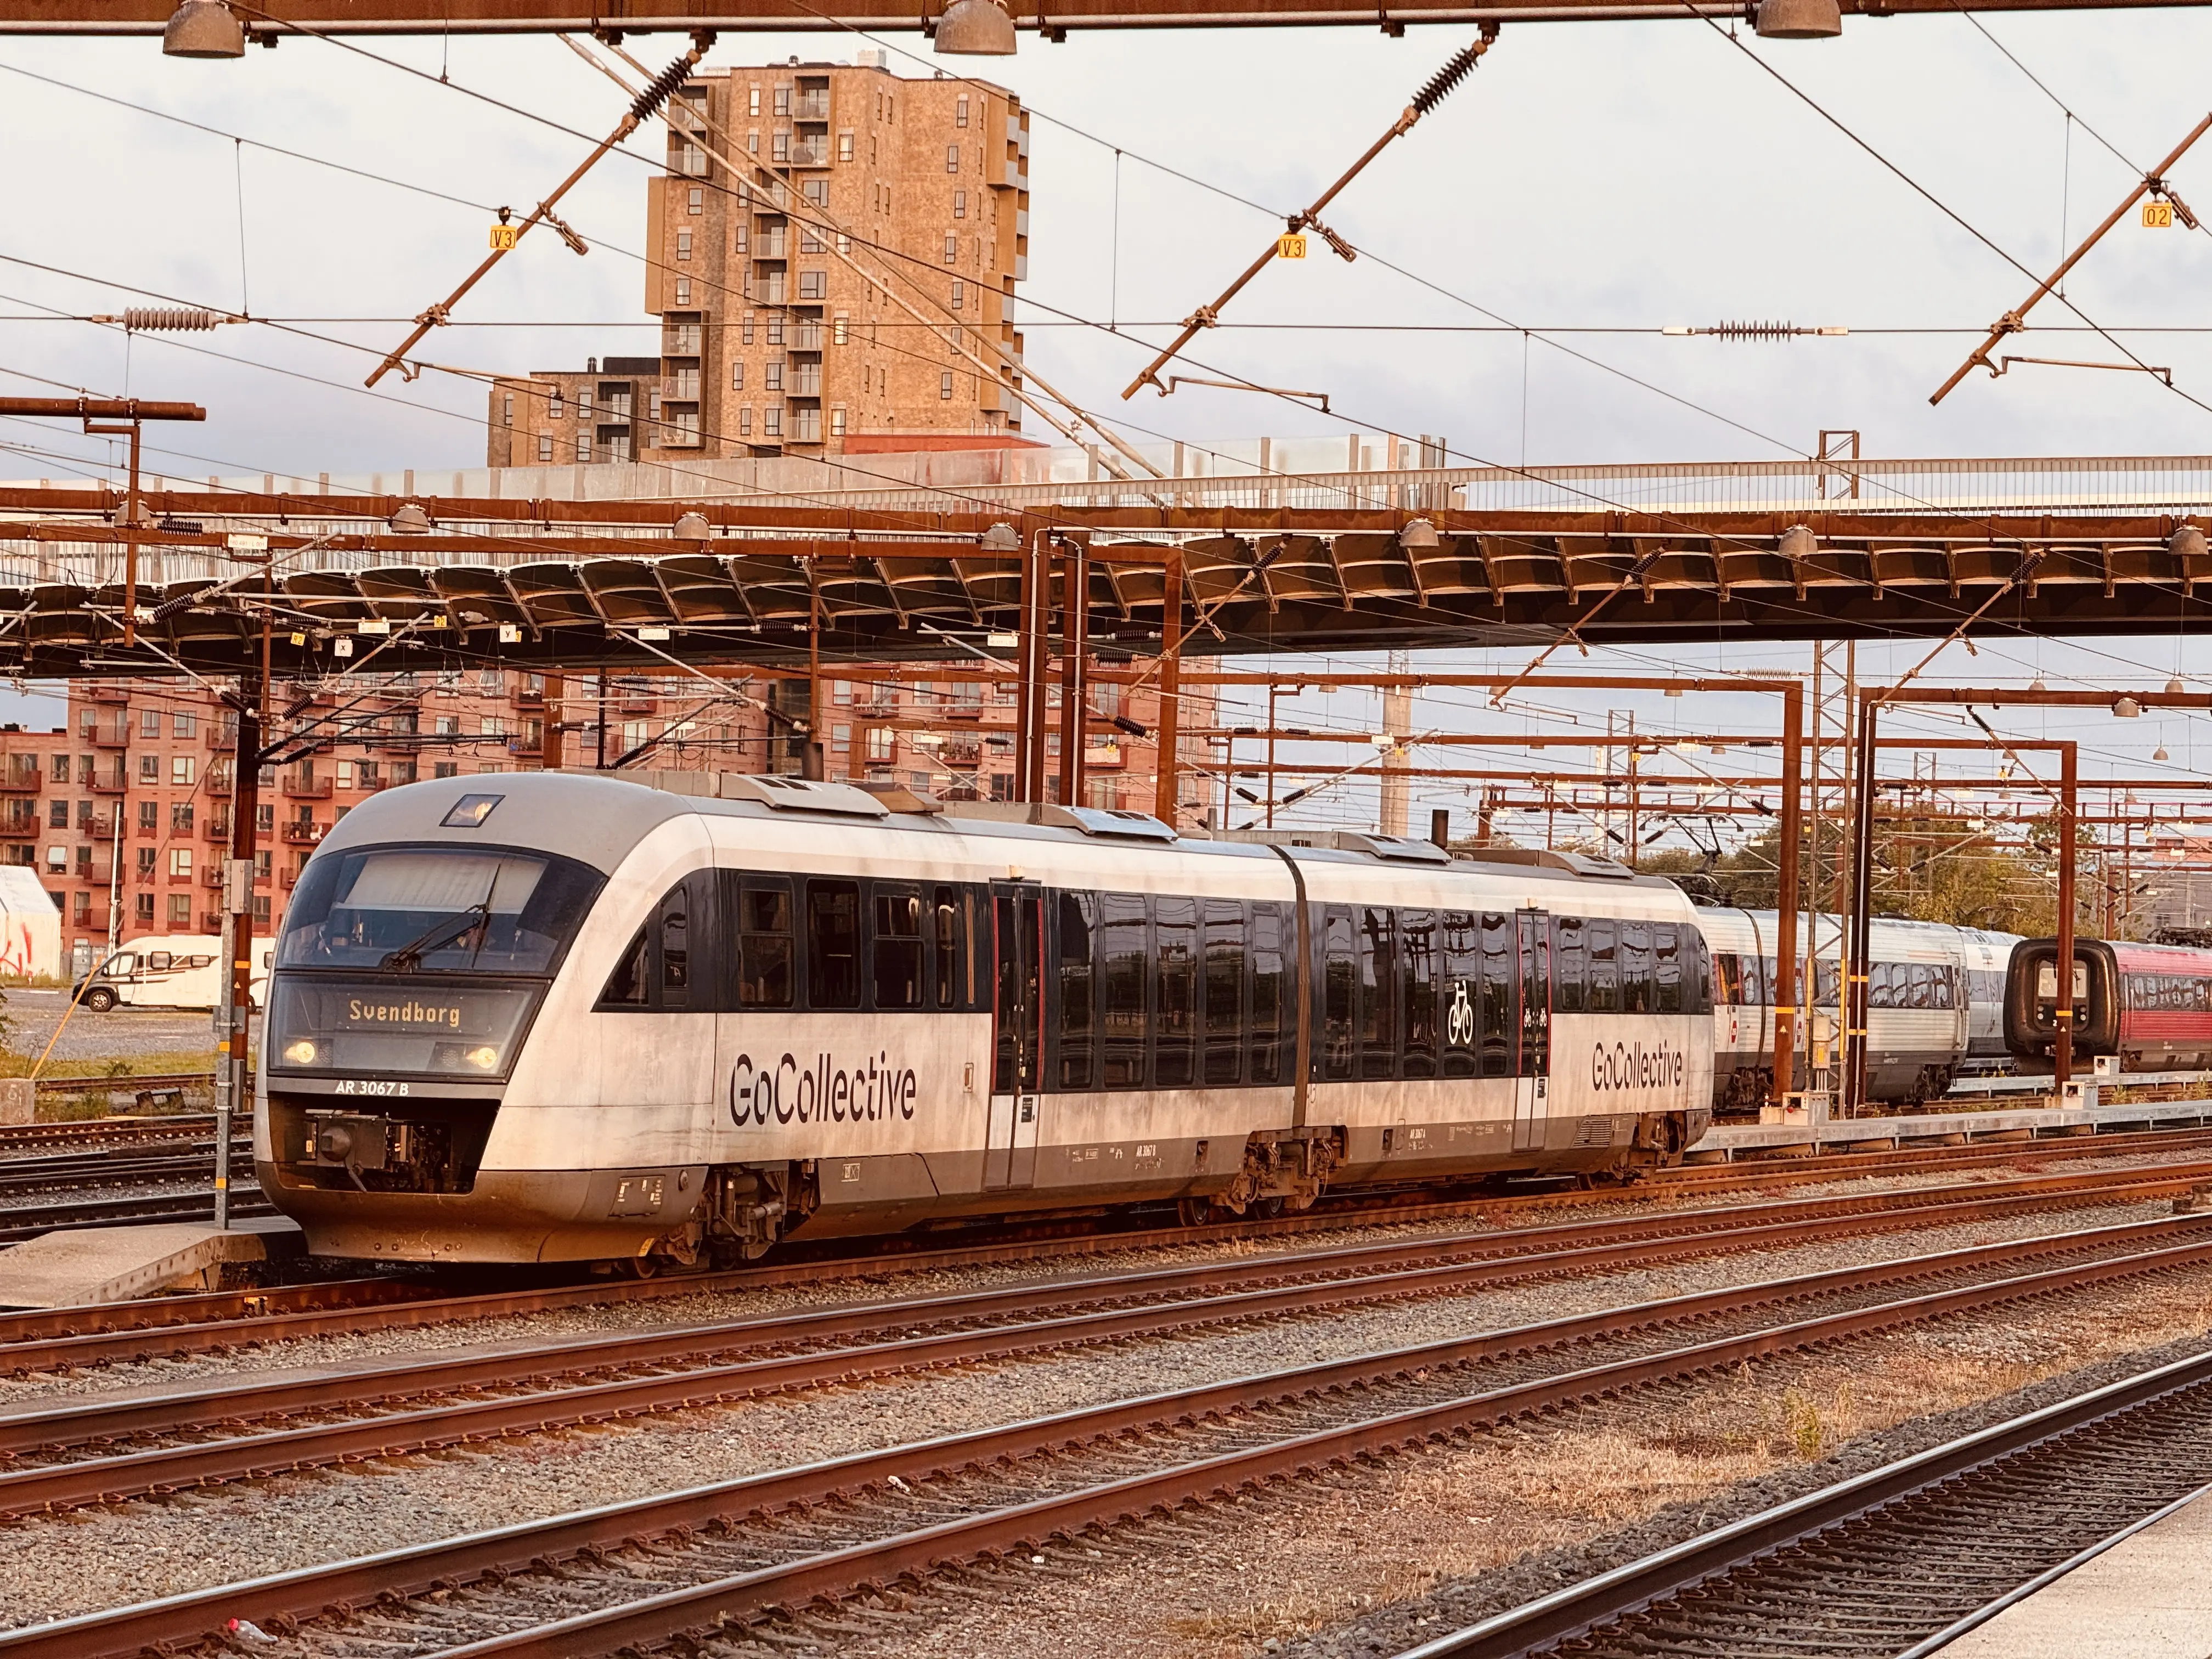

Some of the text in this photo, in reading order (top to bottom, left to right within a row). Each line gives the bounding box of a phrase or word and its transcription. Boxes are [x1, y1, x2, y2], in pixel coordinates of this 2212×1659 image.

[493, 230, 512, 247] V3
[1283, 240, 1302, 257] V3
[436, 618, 444, 627] R2
[294, 635, 302, 645] R2
[349, 999, 460, 1028] Svendborg
[1592, 1039, 1683, 1091] GoCollective
[335, 1080, 409, 1096] AR 3067 B
[730, 1050, 916, 1127] GoCollective
